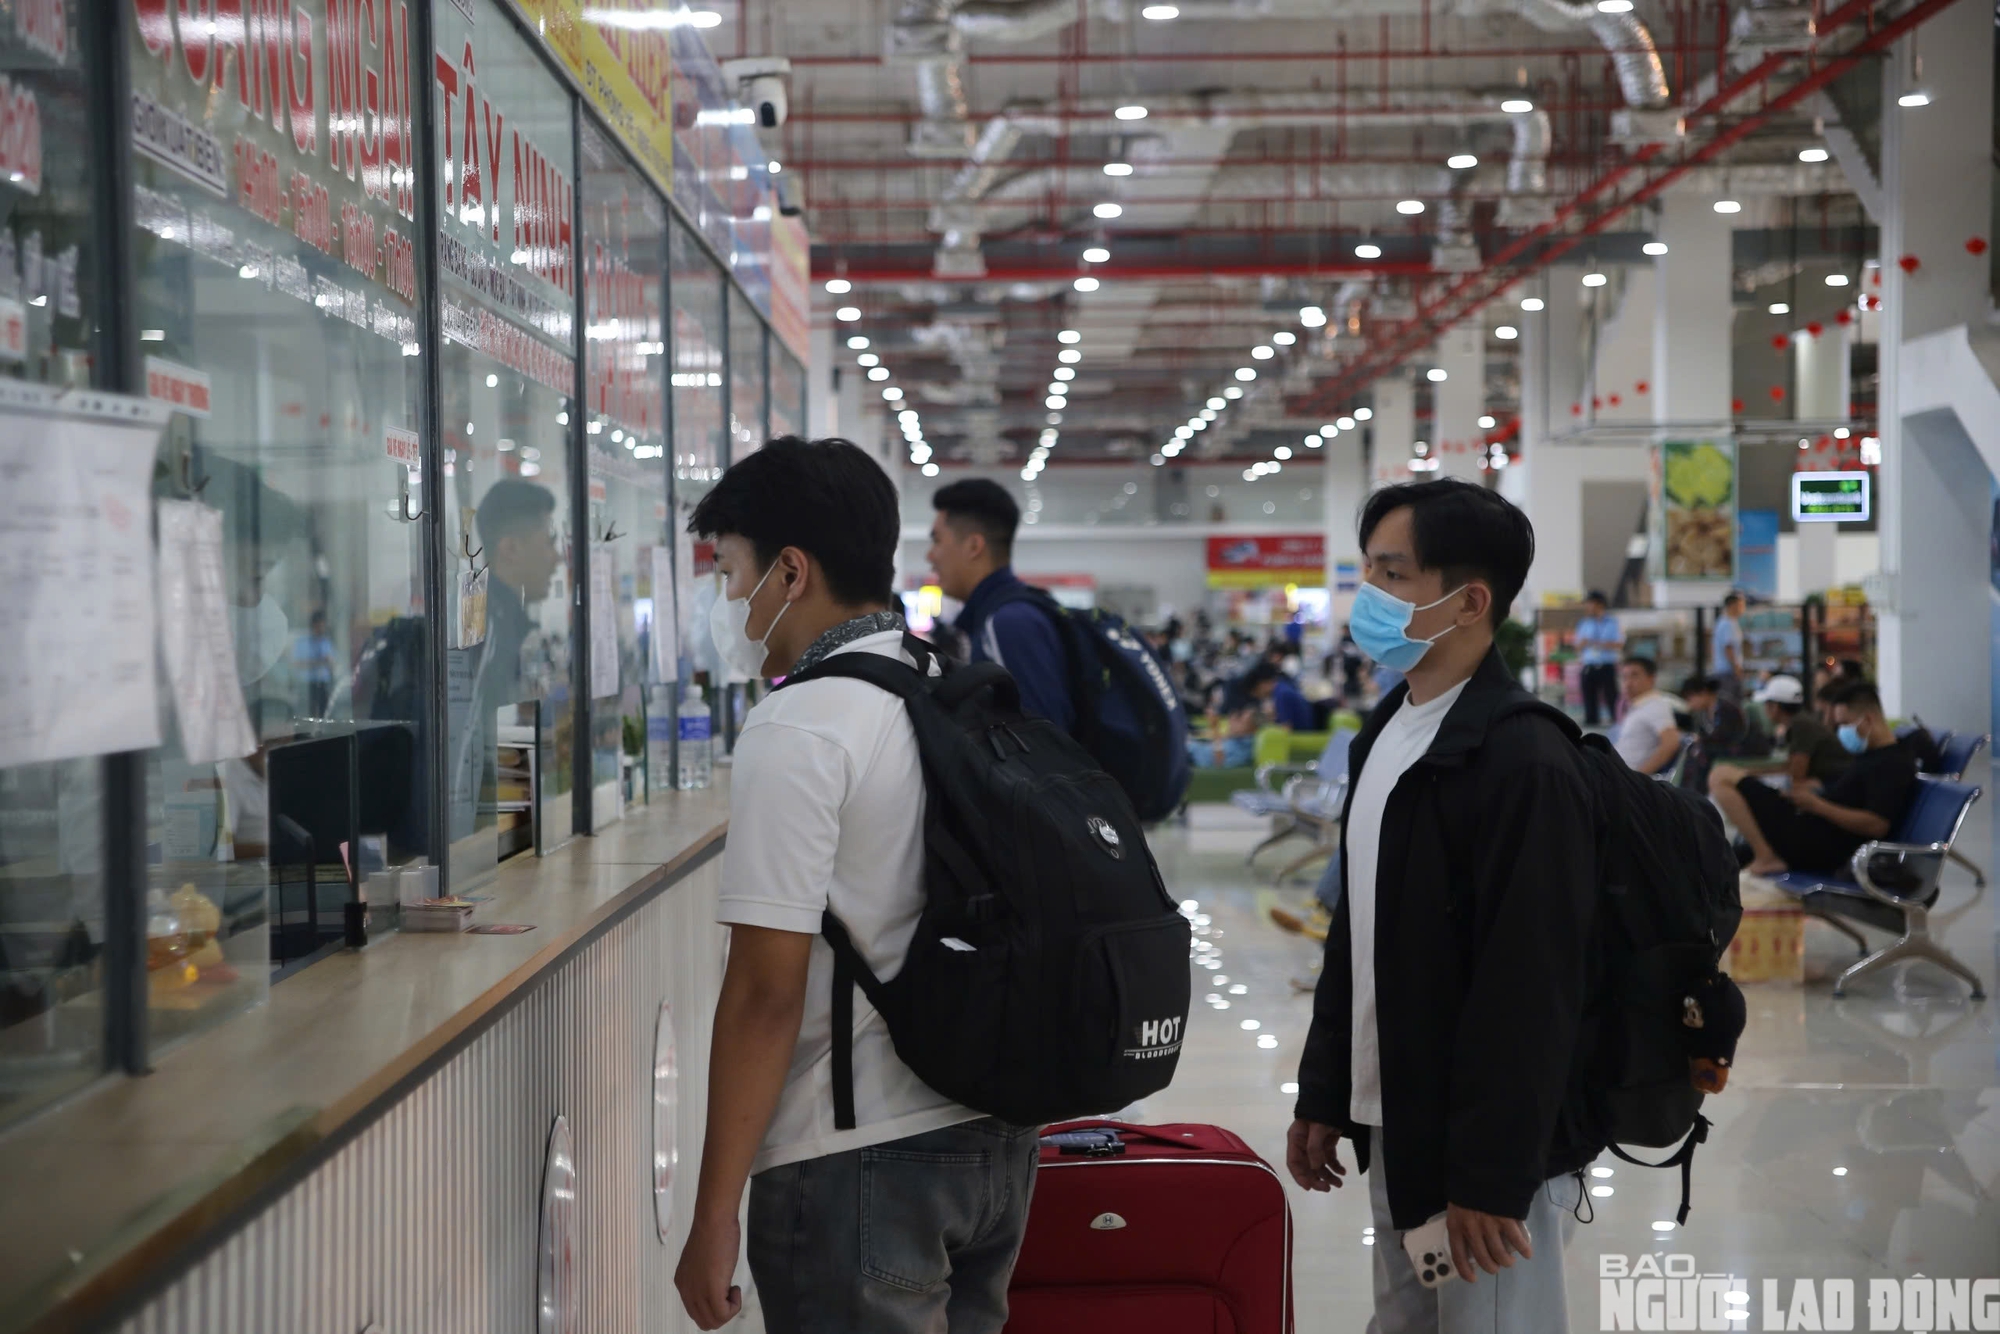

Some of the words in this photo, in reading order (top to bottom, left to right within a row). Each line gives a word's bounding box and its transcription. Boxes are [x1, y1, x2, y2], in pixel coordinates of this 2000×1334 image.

[436, 32, 503, 249] TÂY
[512, 121, 573, 298] NINH
[291, 167, 331, 255] 15h00
[341, 198, 376, 280] 16h00
[383, 225, 414, 301] 17h00
[1141, 1015, 1180, 1046] HOT
